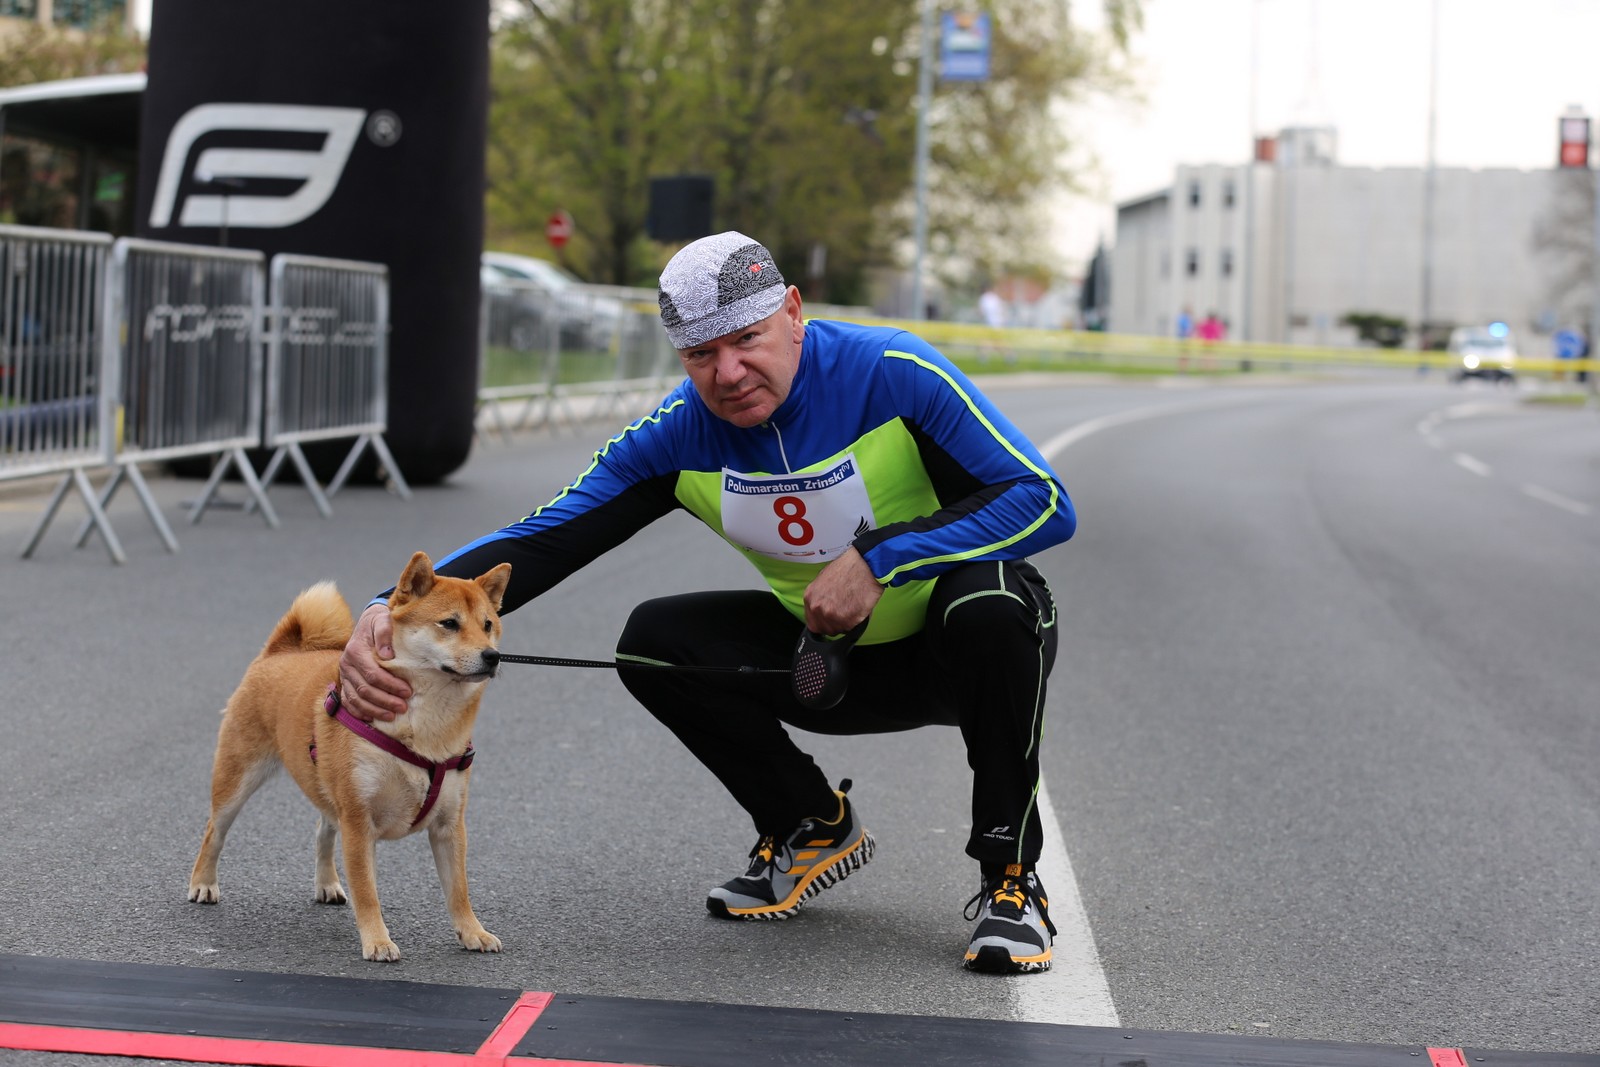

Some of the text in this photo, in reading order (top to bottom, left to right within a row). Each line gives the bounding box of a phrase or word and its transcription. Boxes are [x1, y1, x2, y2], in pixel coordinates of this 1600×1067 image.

[727, 468, 844, 494] Polumaraton Zrinski
[773, 496, 814, 546] 8
